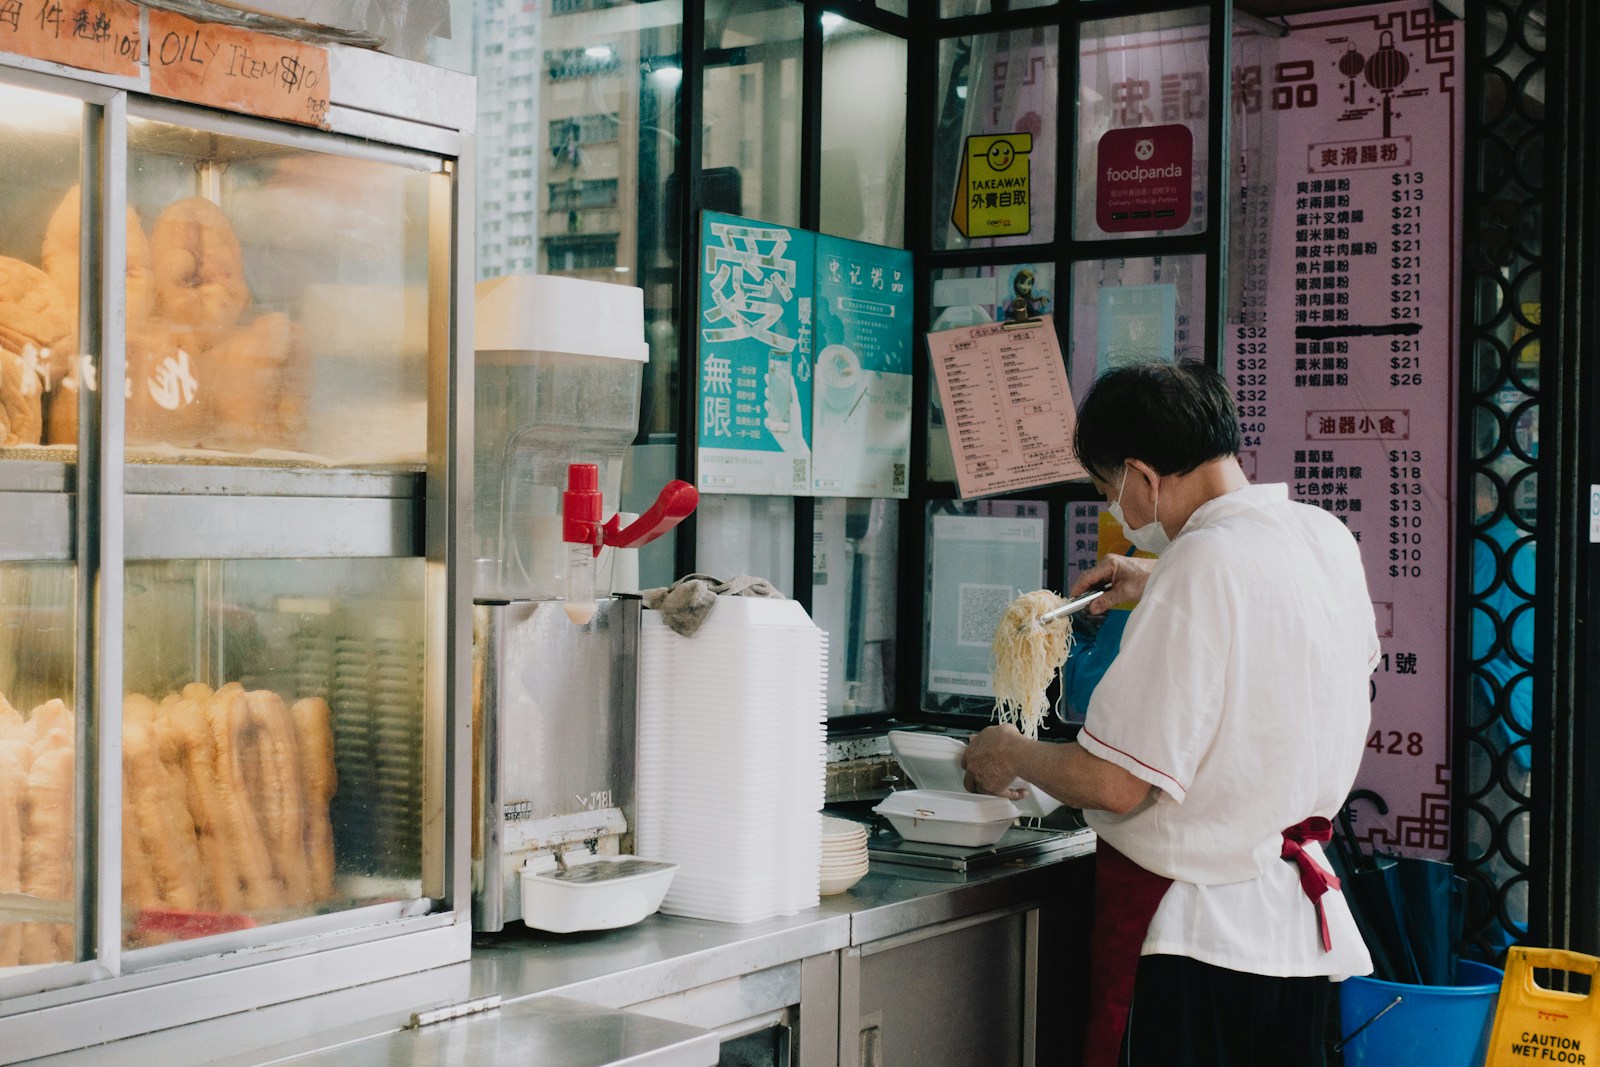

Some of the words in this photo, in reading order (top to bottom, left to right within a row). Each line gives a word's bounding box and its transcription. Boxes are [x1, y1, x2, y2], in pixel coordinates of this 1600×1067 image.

[160, 29, 220, 86] OILY
[1321, 143, 1398, 167] 爽滑腸粉
[1106, 163, 1182, 183] foodpanda
[972, 177, 1026, 190] TAKEAWAY
[1297, 178, 1350, 194] 爽滑腸粉
[1392, 172, 1424, 185] $13
[971, 190, 1026, 209] 外賣自取
[1392, 189, 1424, 202] $13
[1392, 206, 1421, 219] $21
[1392, 223, 1421, 235] $21
[1391, 240, 1421, 252] $21
[1296, 259, 1349, 275] 魚片腸粉
[1391, 256, 1420, 269] $21
[1391, 273, 1420, 286] $21
[702, 222, 797, 353] 愛
[1391, 290, 1420, 302] $21
[1391, 307, 1420, 319] $21
[1237, 327, 1267, 339] $32
[1237, 343, 1267, 355] $32
[1391, 340, 1420, 352] $21
[1237, 359, 1267, 371] $32
[1390, 357, 1420, 369] $21
[1237, 374, 1267, 386] $32
[1390, 373, 1422, 386] $26
[703, 353, 732, 437] 無限
[1237, 390, 1266, 402] $32
[1238, 405, 1266, 417] $32
[1240, 422, 1265, 433] $40
[1319, 416, 1396, 434] 油器小食
[1244, 435, 1261, 446] $4
[1389, 450, 1421, 463] $13
[1390, 466, 1421, 479] $18
[1294, 483, 1348, 495] 七色炒米
[1390, 483, 1421, 495] $13
[1390, 499, 1421, 512] $13
[1389, 516, 1421, 529] $10
[1389, 532, 1421, 545] $10
[1389, 549, 1421, 561] $10
[1389, 565, 1421, 578] $10
[1374, 653, 1417, 674] 1號
[1521, 1032, 1581, 1050] CAUTION
[1511, 1043, 1540, 1058] WET
[1541, 1048, 1586, 1066] FLOOR
